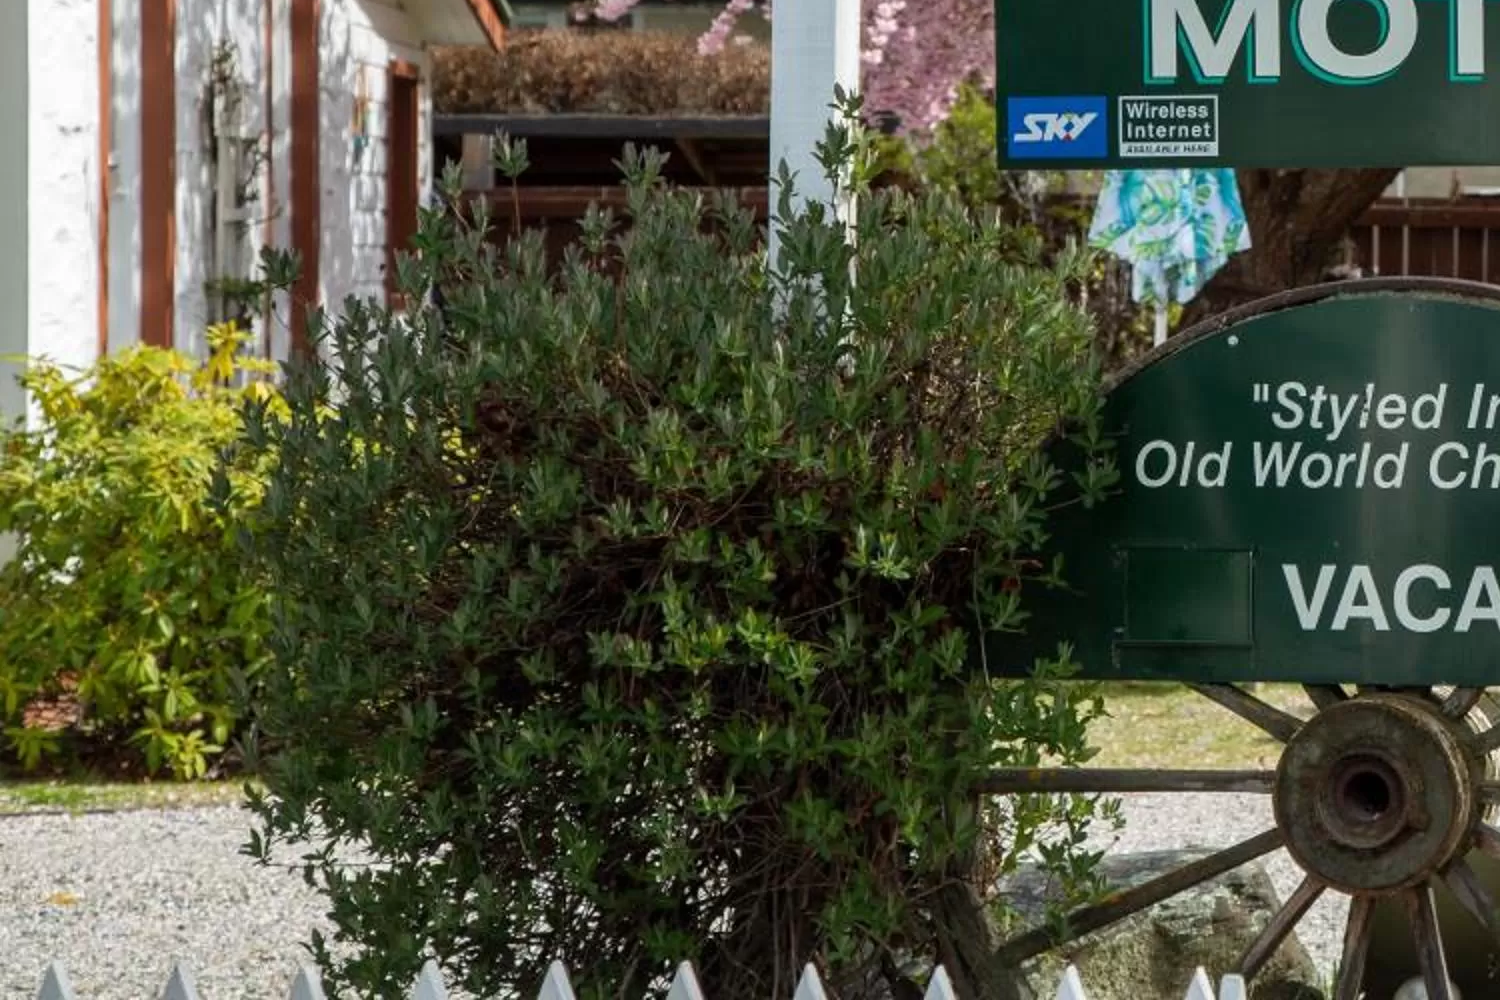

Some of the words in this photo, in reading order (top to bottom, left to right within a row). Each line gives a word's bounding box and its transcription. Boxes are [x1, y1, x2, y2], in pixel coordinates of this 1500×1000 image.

[1125, 101, 1209, 119] Wireless
[1013, 111, 1099, 142] SKY
[1126, 121, 1212, 139] Internet
[1183, 143, 1211, 153] HERE
[1252, 381, 1448, 440] "Styled
[1134, 440, 1232, 488] Old
[1252, 441, 1415, 489] World
